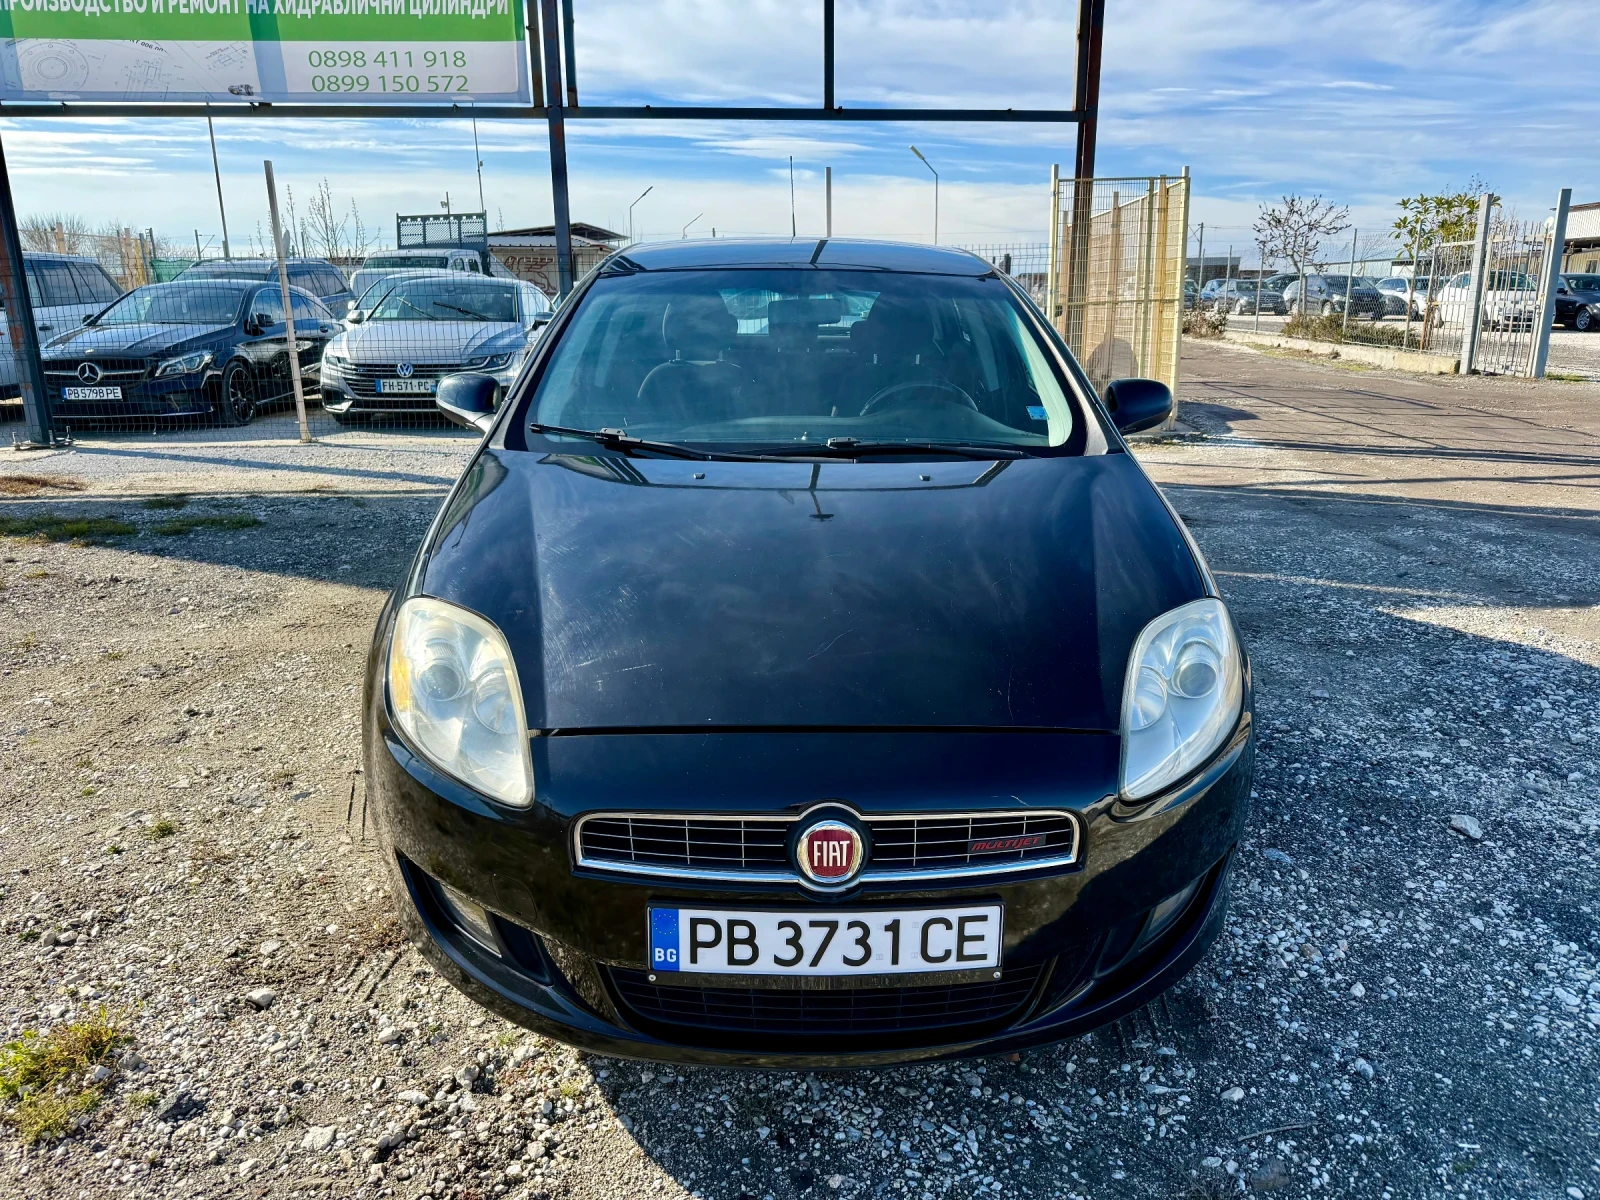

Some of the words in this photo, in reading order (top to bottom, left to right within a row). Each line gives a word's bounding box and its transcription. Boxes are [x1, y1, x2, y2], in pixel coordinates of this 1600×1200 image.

[168, 0, 239, 14] РЕМОНТ
[245, 0, 270, 14] НА
[273, 0, 406, 19] ХИДРАВЛИЧНИ
[410, 0, 509, 19] ЦИЛИНДРИ
[308, 50, 367, 68] 0898
[373, 50, 413, 68] 411
[423, 50, 467, 68] 918
[311, 75, 370, 92] 0899
[378, 75, 420, 92] 150
[427, 75, 469, 92] 572
[105, 387, 121, 398] PE
[971, 836, 1042, 851] MULTIJET
[813, 840, 851, 867] FIAT
[689, 917, 760, 966] PB
[773, 918, 901, 967] 3731
[920, 914, 989, 964] CE
[654, 947, 677, 963] BG
